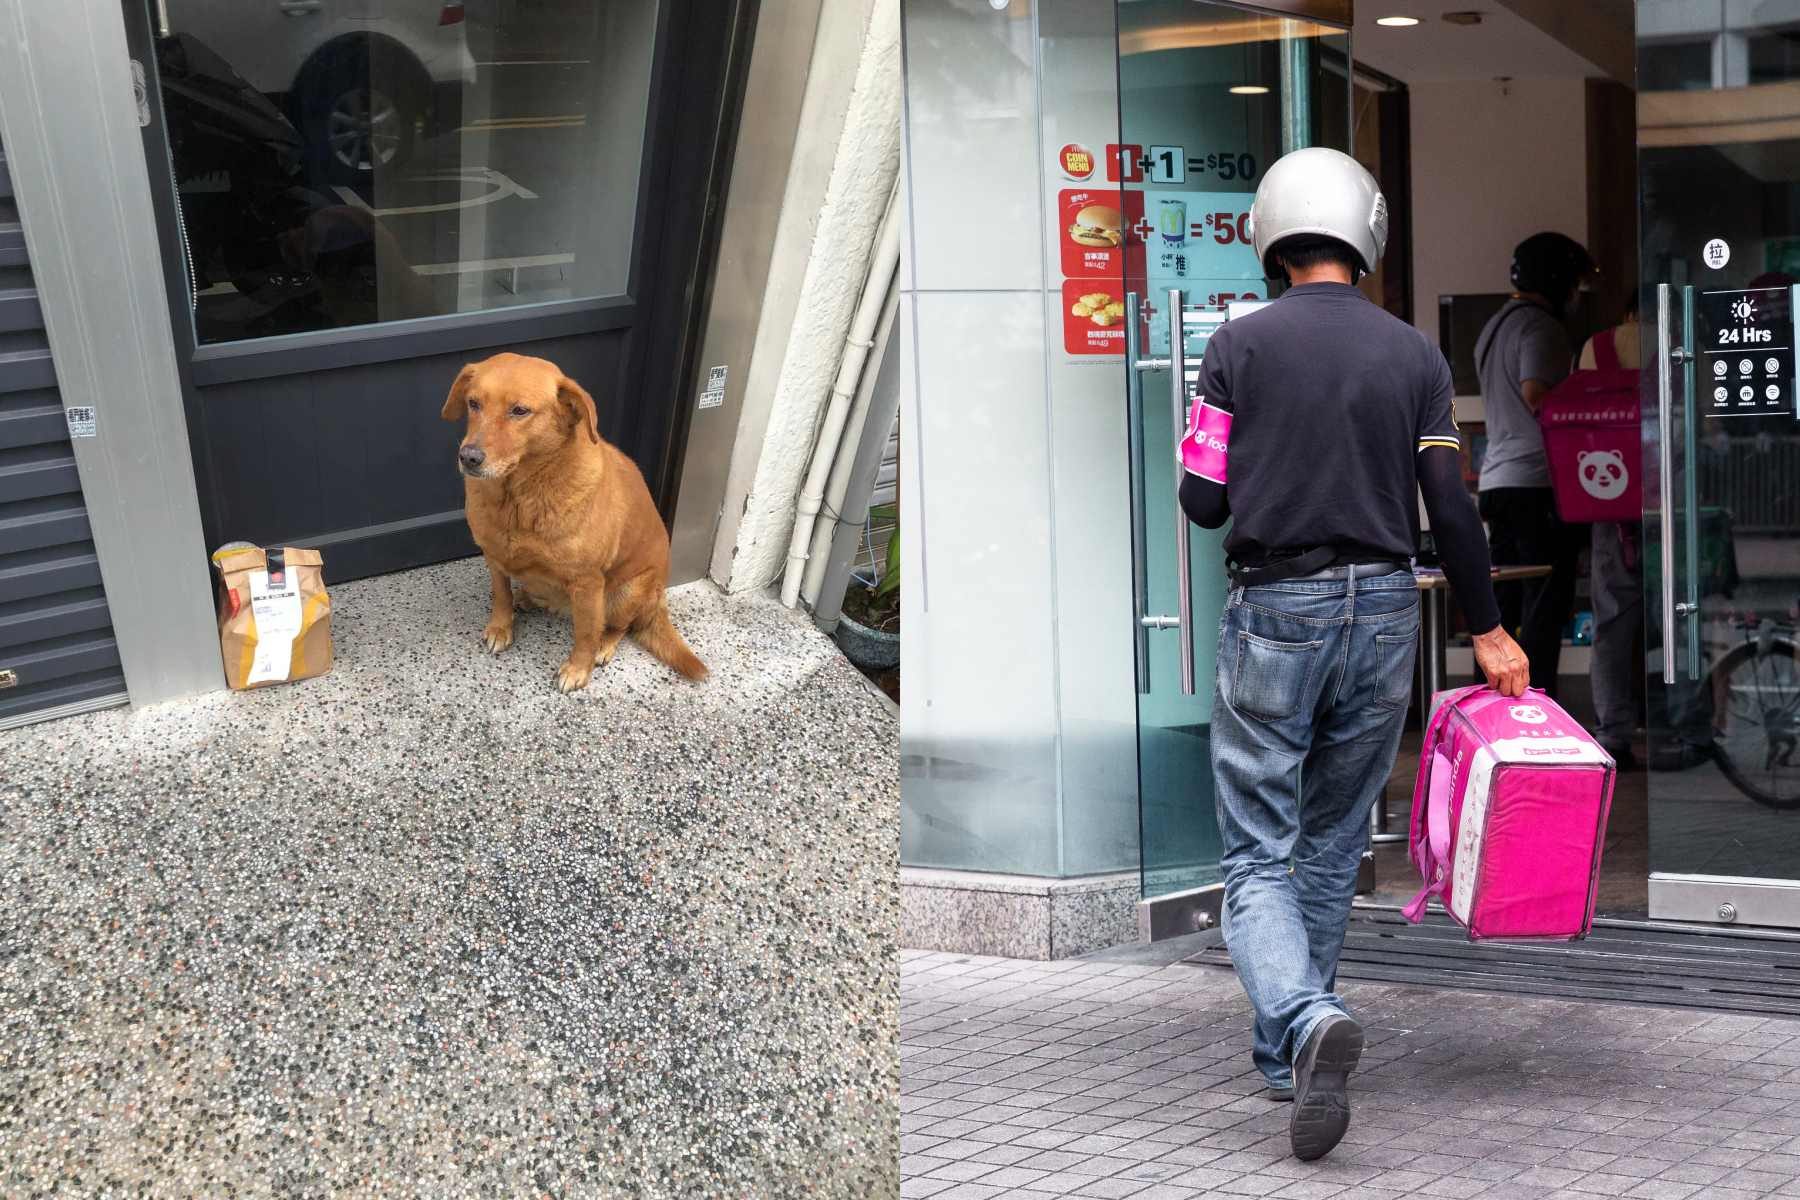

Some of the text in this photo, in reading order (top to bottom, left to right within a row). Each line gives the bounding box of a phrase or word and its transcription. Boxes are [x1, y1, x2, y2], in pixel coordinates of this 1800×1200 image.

[1066, 152, 1088, 163] COIN
[1067, 161, 1090, 172] MENU
[1709, 243, 1723, 260] 拉
[1175, 254, 1186, 271] 推
[1718, 327, 1772, 344] 24 Hrs
[1207, 436, 1228, 453] foo
